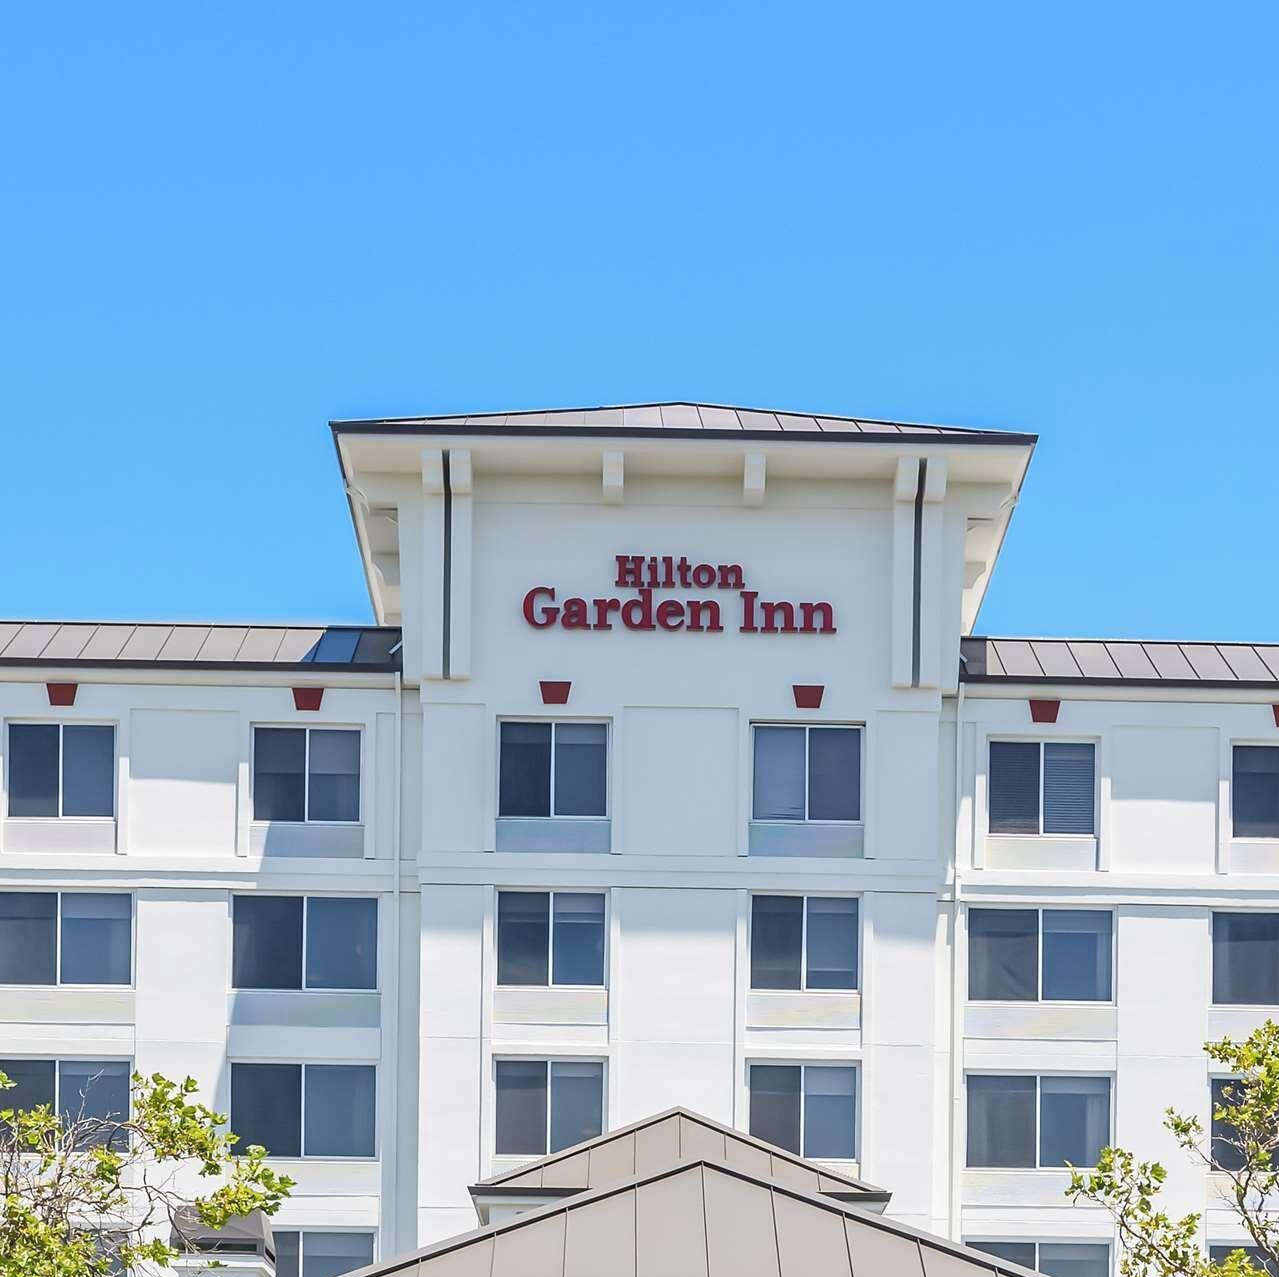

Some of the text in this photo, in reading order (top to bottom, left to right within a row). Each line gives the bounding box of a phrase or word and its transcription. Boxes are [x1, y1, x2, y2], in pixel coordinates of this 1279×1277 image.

[615, 555, 745, 589] Hilton
[522, 586, 837, 633] Garden Inn
